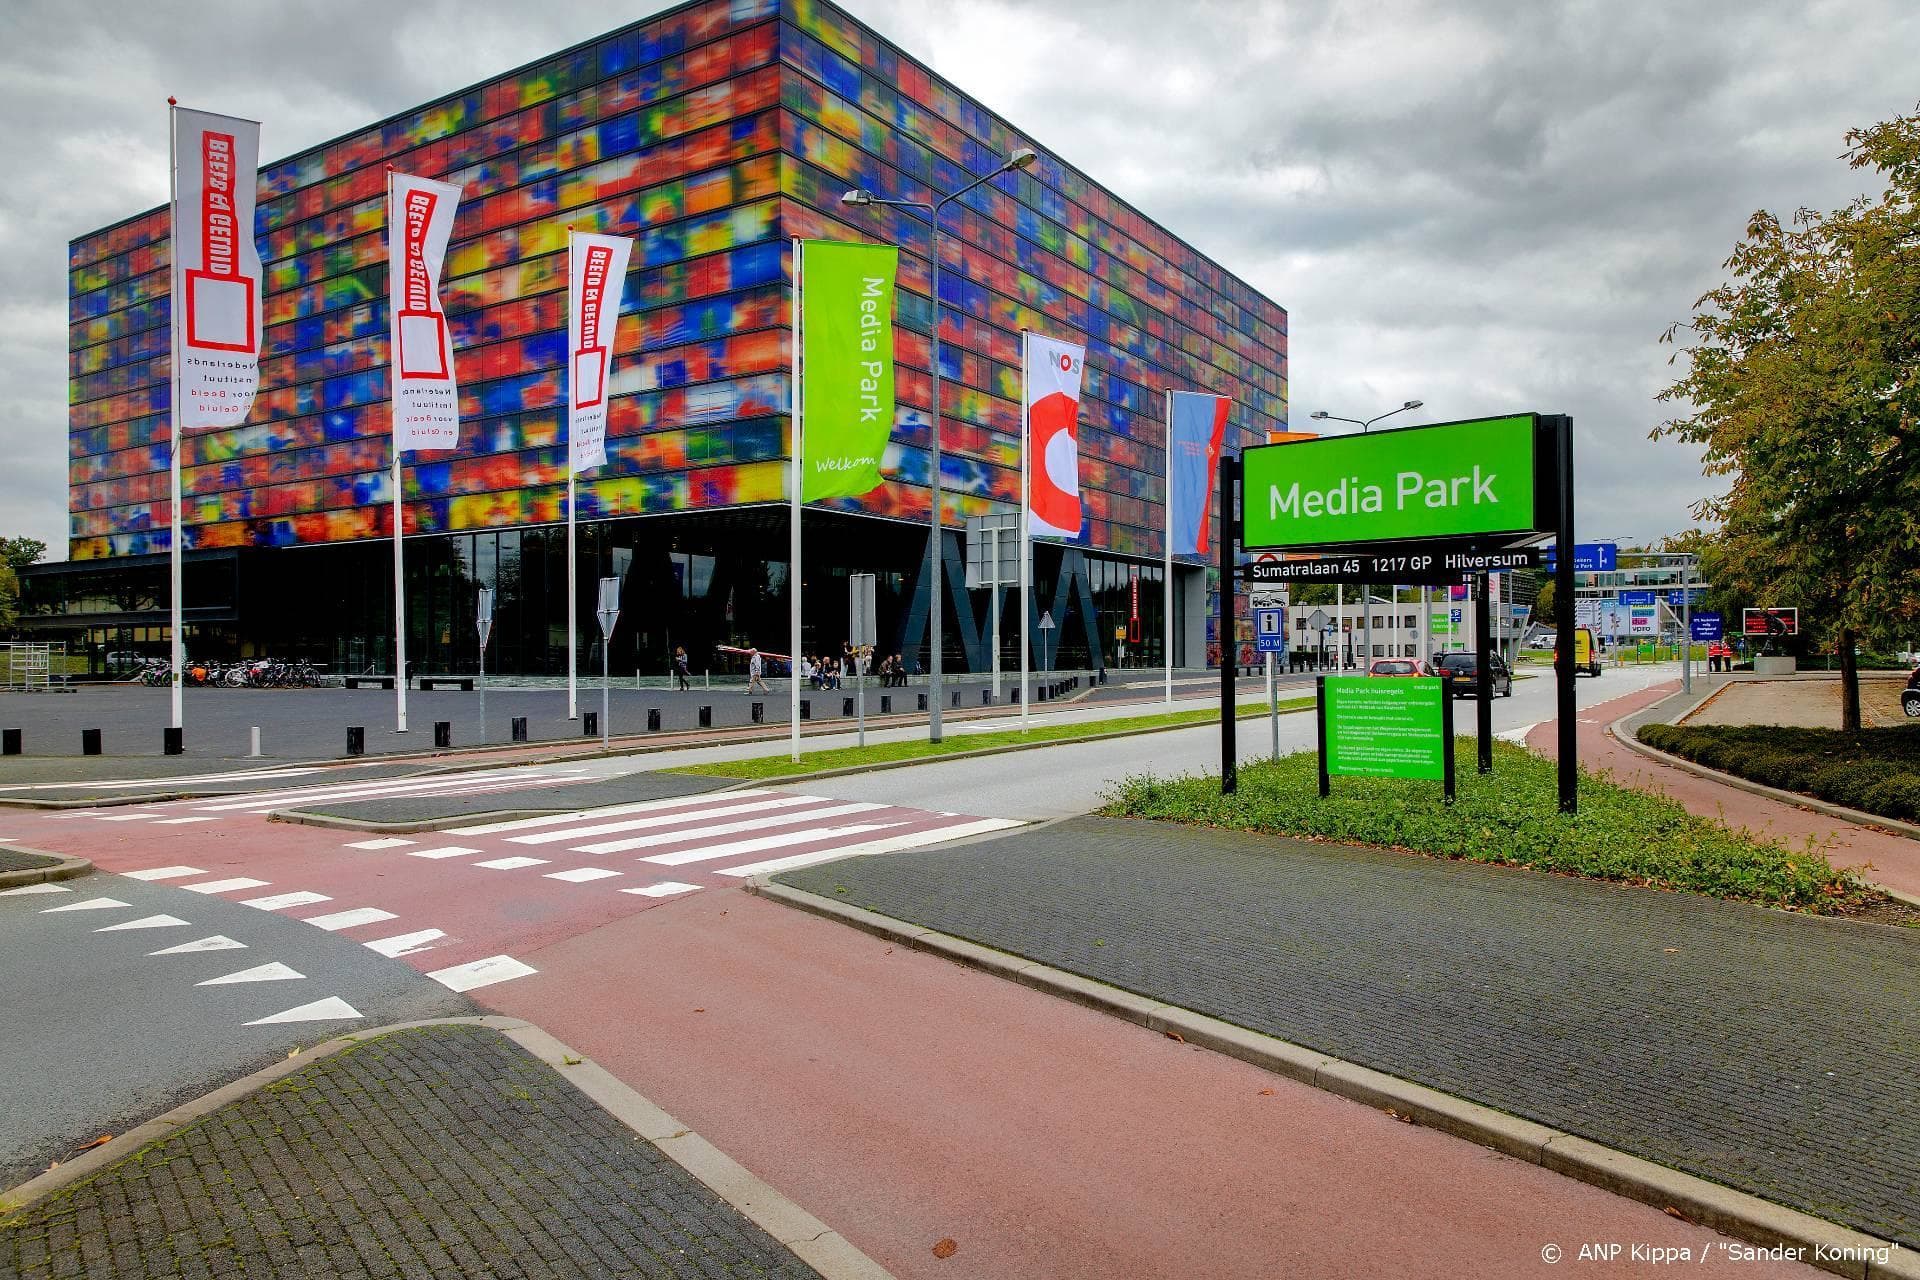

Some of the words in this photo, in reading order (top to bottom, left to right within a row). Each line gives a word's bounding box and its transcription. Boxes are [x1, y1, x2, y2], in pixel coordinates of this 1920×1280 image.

[860, 277, 885, 351] Media
[1049, 350, 1080, 375] NOS
[860, 361, 883, 423] Park
[815, 456, 877, 473] Welkom
[1270, 476, 1383, 520] Media
[1397, 464, 1499, 511] Park
[1253, 561, 1340, 578] Sumatralaan
[1342, 559, 1360, 574] 45
[1372, 557, 1407, 572] 1217
[1410, 556, 1433, 570] GP
[1445, 553, 1528, 569] Hilversum
